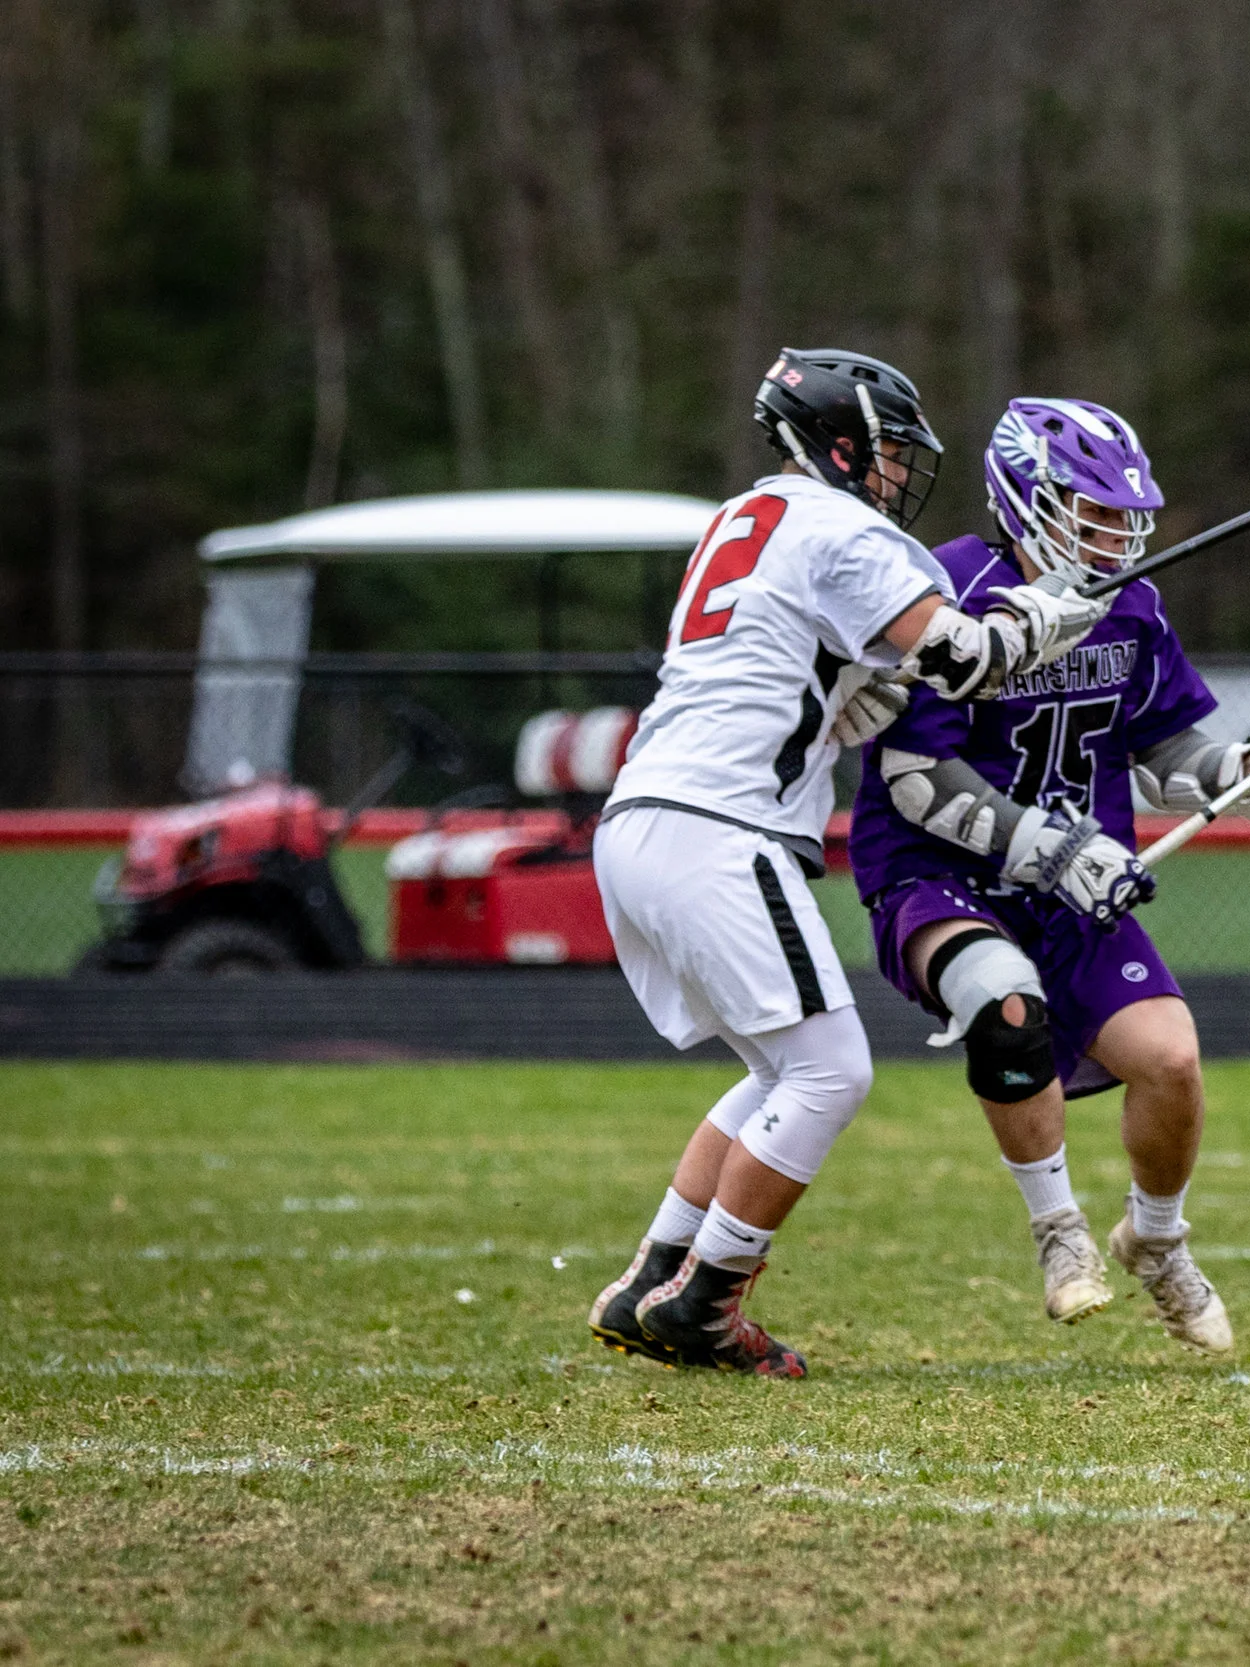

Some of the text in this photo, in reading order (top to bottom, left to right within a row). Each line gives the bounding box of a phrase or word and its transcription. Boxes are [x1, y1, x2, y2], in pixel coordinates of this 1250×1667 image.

[666, 493, 788, 646] 2
[996, 639, 1138, 701] ARSHWOOD
[1006, 693, 1122, 817] 15
